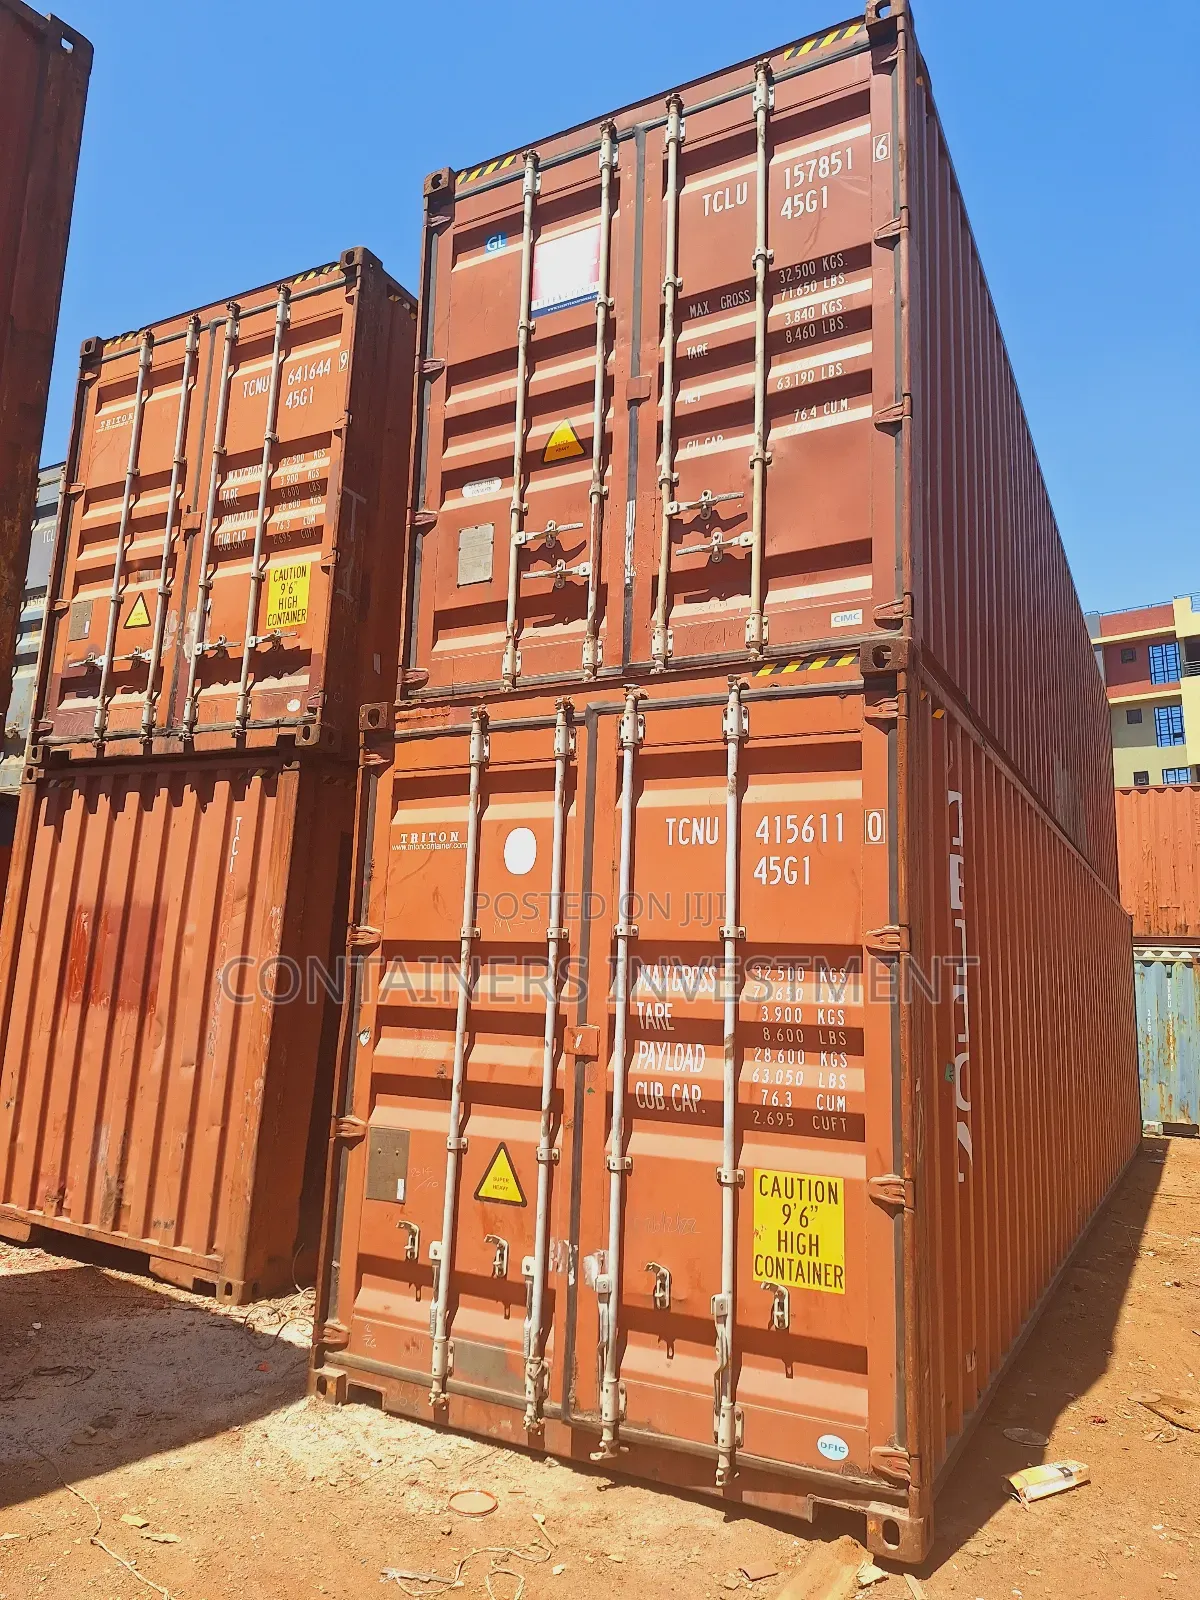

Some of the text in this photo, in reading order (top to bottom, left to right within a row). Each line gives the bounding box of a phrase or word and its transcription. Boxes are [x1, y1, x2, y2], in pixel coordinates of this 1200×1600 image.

[702, 137, 888, 217] TCLU 157851 6
[780, 185, 828, 220] 45G1
[486, 235, 505, 251] GL
[720, 289, 750, 310] GROSS
[822, 253, 848, 272] KGS.
[687, 342, 708, 360] TARE
[821, 299, 847, 316] KGS.
[822, 316, 848, 334] LBS.
[243, 375, 270, 399] TCNU
[288, 358, 331, 386] 641644
[285, 386, 314, 409] 45G1
[273, 565, 307, 582] CAUTION
[278, 595, 298, 610] HIGH
[267, 609, 307, 627] CONTAINER
[833, 612, 860, 624] CIMC
[400, 831, 459, 844] TRITON
[665, 816, 719, 846] TCNU
[755, 812, 843, 845] 415611
[753, 855, 811, 886] 45G1
[820, 966, 847, 983] KGS
[637, 1001, 675, 1031] TARE
[817, 1008, 845, 1026] KGS
[819, 1029, 847, 1046] LBS
[637, 1041, 705, 1073] PAYLOAD
[820, 1050, 848, 1068] KGS
[818, 1071, 847, 1090] LBS
[761, 1089, 793, 1108] 76.3
[816, 1093, 846, 1113] CUM
[812, 1115, 847, 1133] CUFT
[759, 1174, 838, 1205] CAUTION
[777, 1229, 819, 1257] HIGH
[754, 1254, 843, 1289] CONTAINER
[820, 1441, 846, 1453] DFIC
